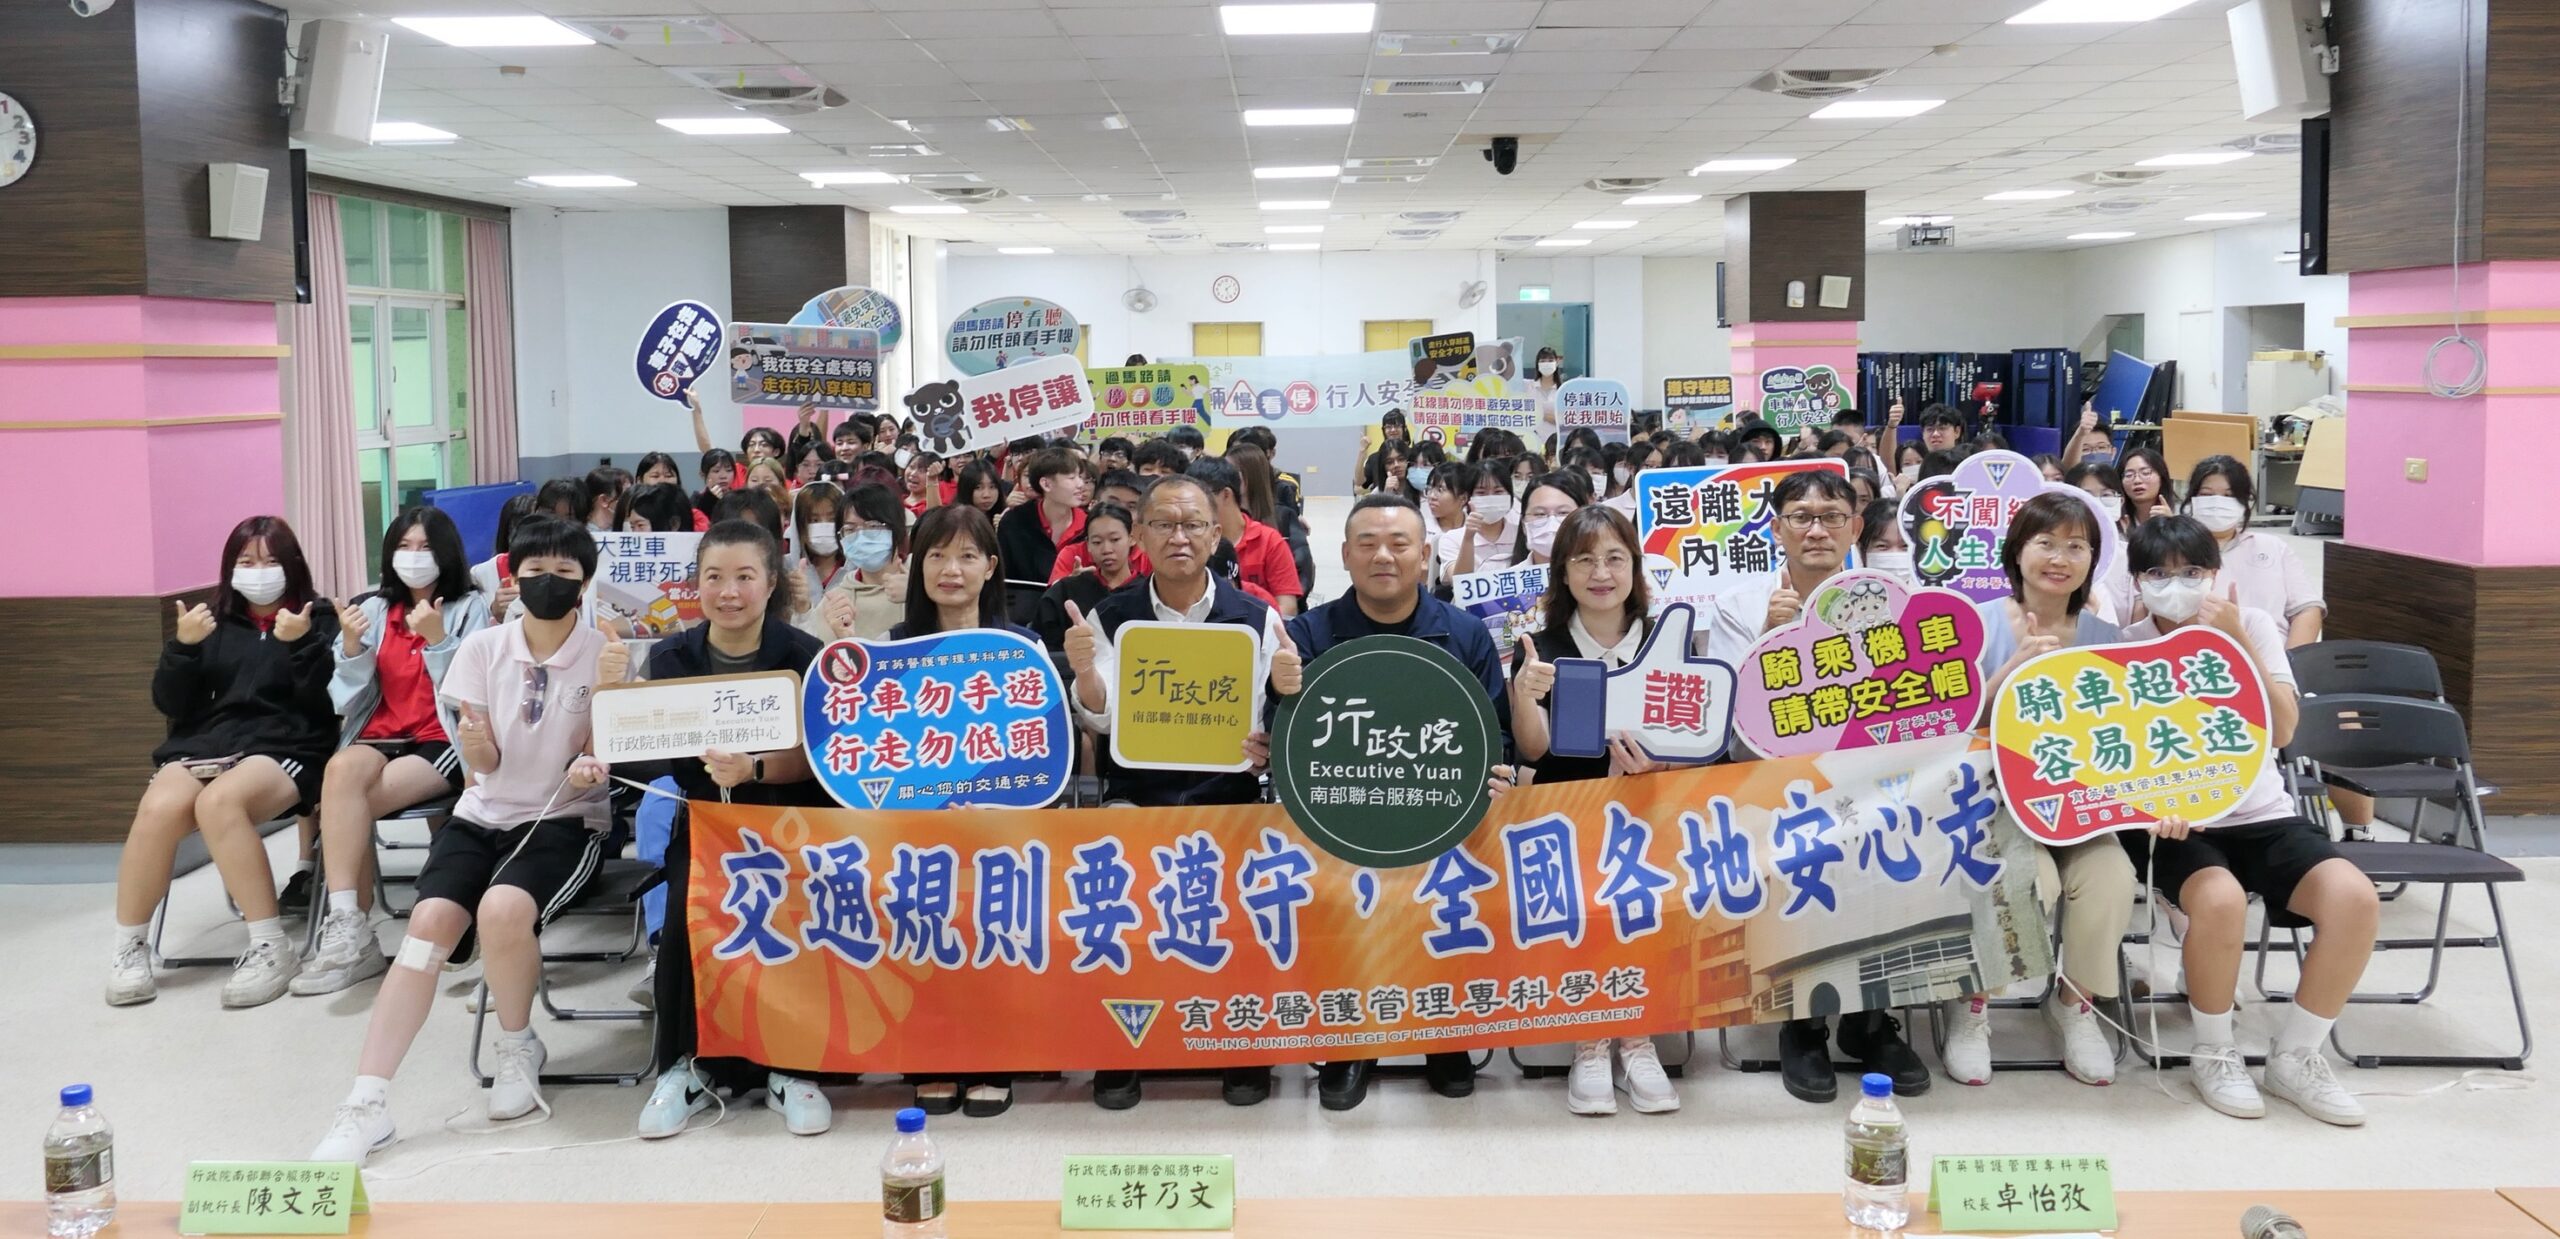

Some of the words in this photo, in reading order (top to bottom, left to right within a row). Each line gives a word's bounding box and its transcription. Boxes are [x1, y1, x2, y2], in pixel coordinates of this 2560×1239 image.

[13, 115, 25, 129] 2
[19, 130, 31, 145] 3
[13, 149, 26, 163] 4
[952, 328, 1074, 352] 請勿低頭看手機
[762, 355, 873, 377] 我在安全處等待
[1105, 369, 1171, 385] 過馬路請
[762, 376, 873, 398] 走在行人穿越道
[1564, 391, 1624, 407] 停讓行人
[971, 374, 1082, 428] 我停讓
[1564, 410, 1624, 425] 從我開始
[595, 536, 666, 557] 大型車
[1683, 533, 1787, 577] 內輪
[1461, 568, 1551, 600] 3D酒駕
[876, 648, 1026, 672] 育英醫護管理專科學校
[1761, 616, 1960, 690] 騎乘機車
[1131, 658, 1239, 706] 行政院
[2016, 653, 2238, 722] 騎車超速
[712, 689, 781, 715] 行政院
[825, 671, 1046, 723] 行車勿手遊
[1643, 669, 1707, 731] 讚
[1770, 659, 1970, 737] 請帶安全帽
[1133, 711, 1239, 727] 南部聯合服務中心
[1312, 696, 1463, 760] 行政院
[608, 726, 781, 752] 行政院南部聯合服務中心
[825, 719, 1049, 773] 行走勿低頭
[2033, 710, 2254, 782] 容易失速
[1310, 761, 1405, 779] Executive
[1412, 763, 1462, 780] Yuan
[2069, 763, 2238, 804] 育英醫護管理專科學校
[897, 773, 1050, 800] 關心您的交通安全
[1310, 786, 1462, 807] 南部聯合服務中心
[1177, 969, 1646, 1030] 育英醫護管理專科學校
[1185, 1038, 1250, 1050] YUH-ING
[1253, 1036, 1310, 1049] JUNIOR
[1313, 1033, 1384, 1047] COLLEGE
[1388, 1032, 1409, 1043] OF
[1413, 1025, 1472, 1041] HEALTH
[1477, 1020, 1517, 1034] CARE
[1522, 1018, 1531, 1028] &
[1534, 1007, 1644, 1027] MANAGEMENT
[192, 1169, 340, 1183] 行政院南部聯合服務中心
[1068, 1164, 1219, 1177] 行政院南部聯合服務中心
[1938, 1158, 2109, 1173] 育英醫護管理專科學校
[247, 1185, 337, 1217] 陳文亮
[1121, 1181, 1215, 1210] 許乃文
[1962, 1198, 1990, 1212] 校長
[1997, 1182, 2092, 1213] 卓怡孜
